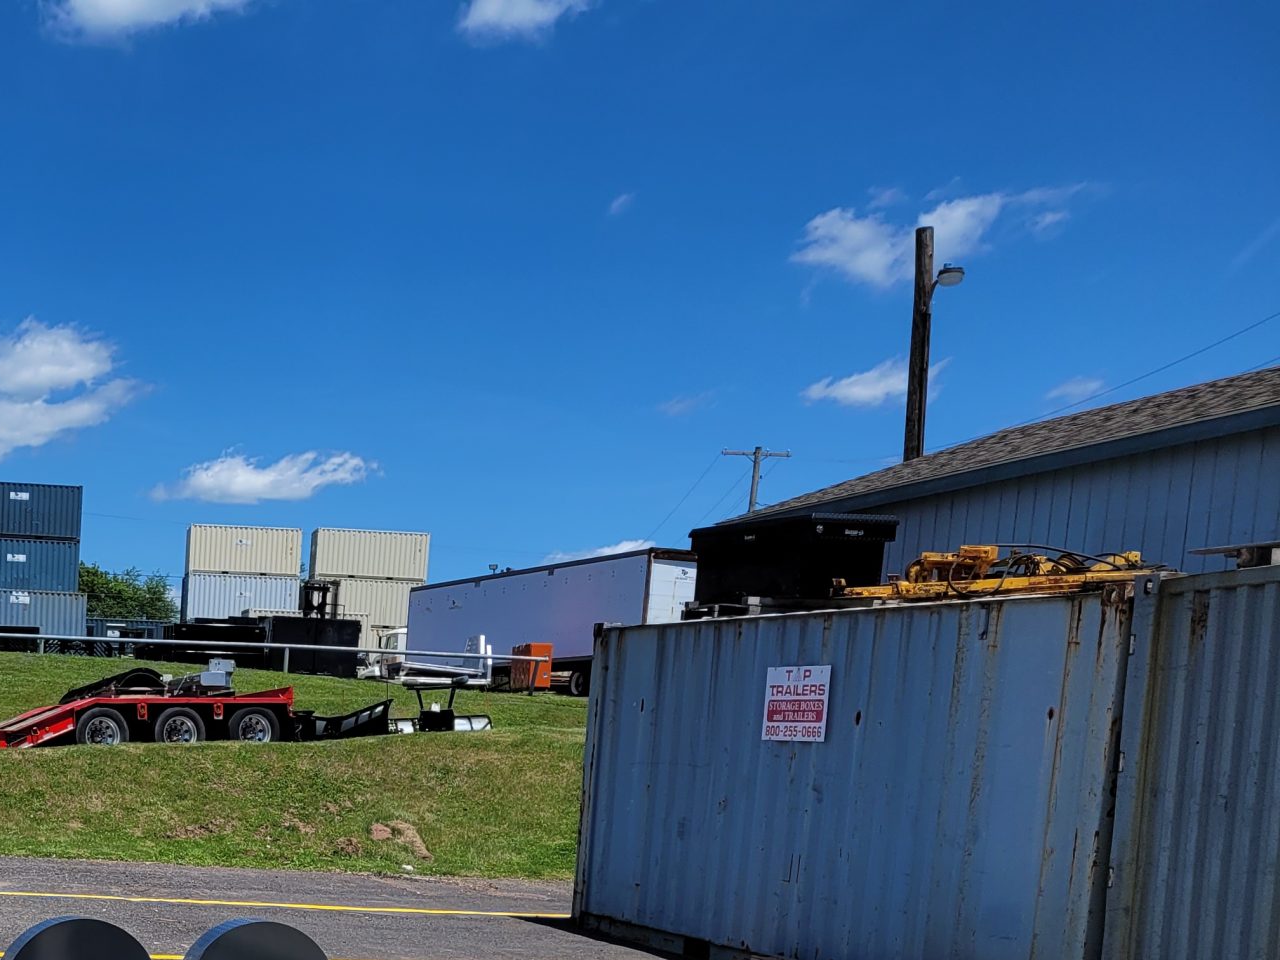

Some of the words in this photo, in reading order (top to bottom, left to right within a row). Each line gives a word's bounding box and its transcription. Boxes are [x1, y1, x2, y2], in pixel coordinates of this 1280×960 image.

[769, 684, 826, 697] TRAILERS
[769, 701, 799, 711] STORAGE
[800, 701, 823, 711] BOXES
[773, 712, 784, 721] and
[785, 711, 817, 721] TRAILERS
[765, 725, 822, 738] 800-255-0666
